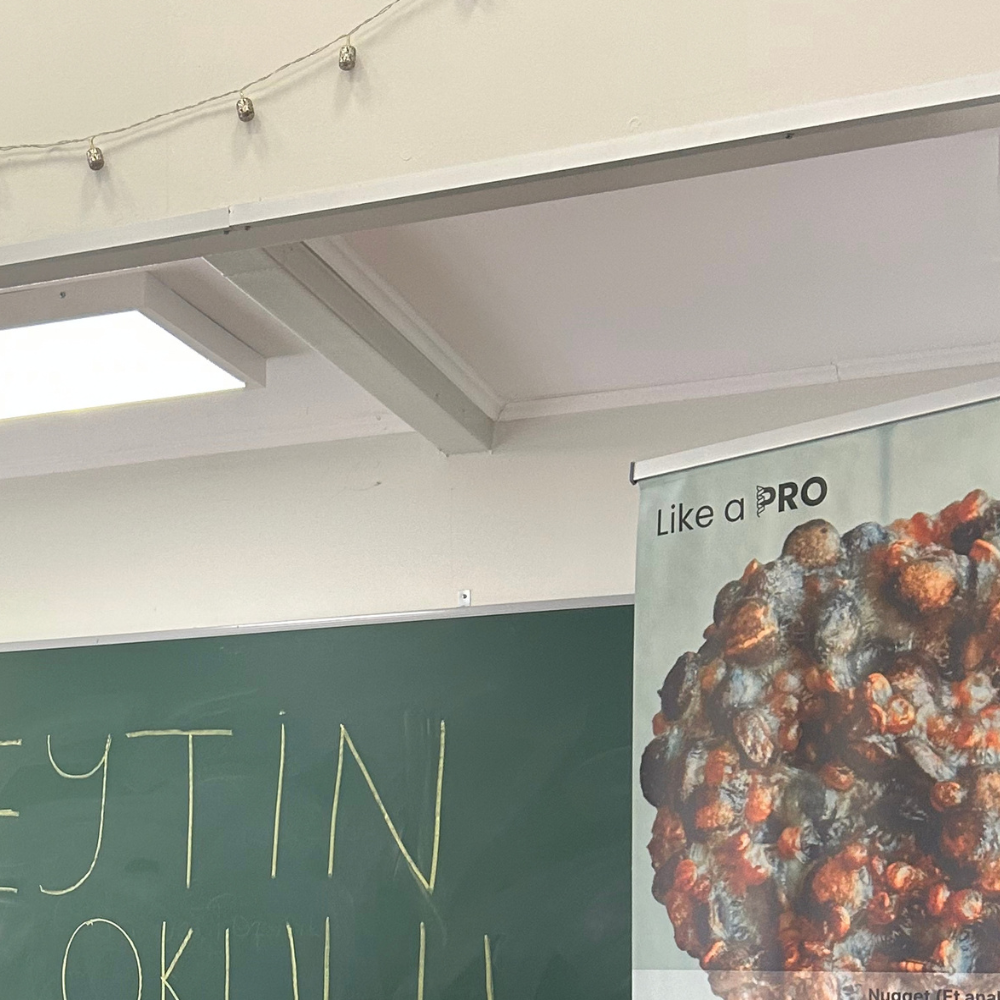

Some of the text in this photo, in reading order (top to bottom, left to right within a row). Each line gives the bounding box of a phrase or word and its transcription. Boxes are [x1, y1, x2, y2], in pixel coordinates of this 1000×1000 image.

[657, 476, 828, 536] Like a PRO
